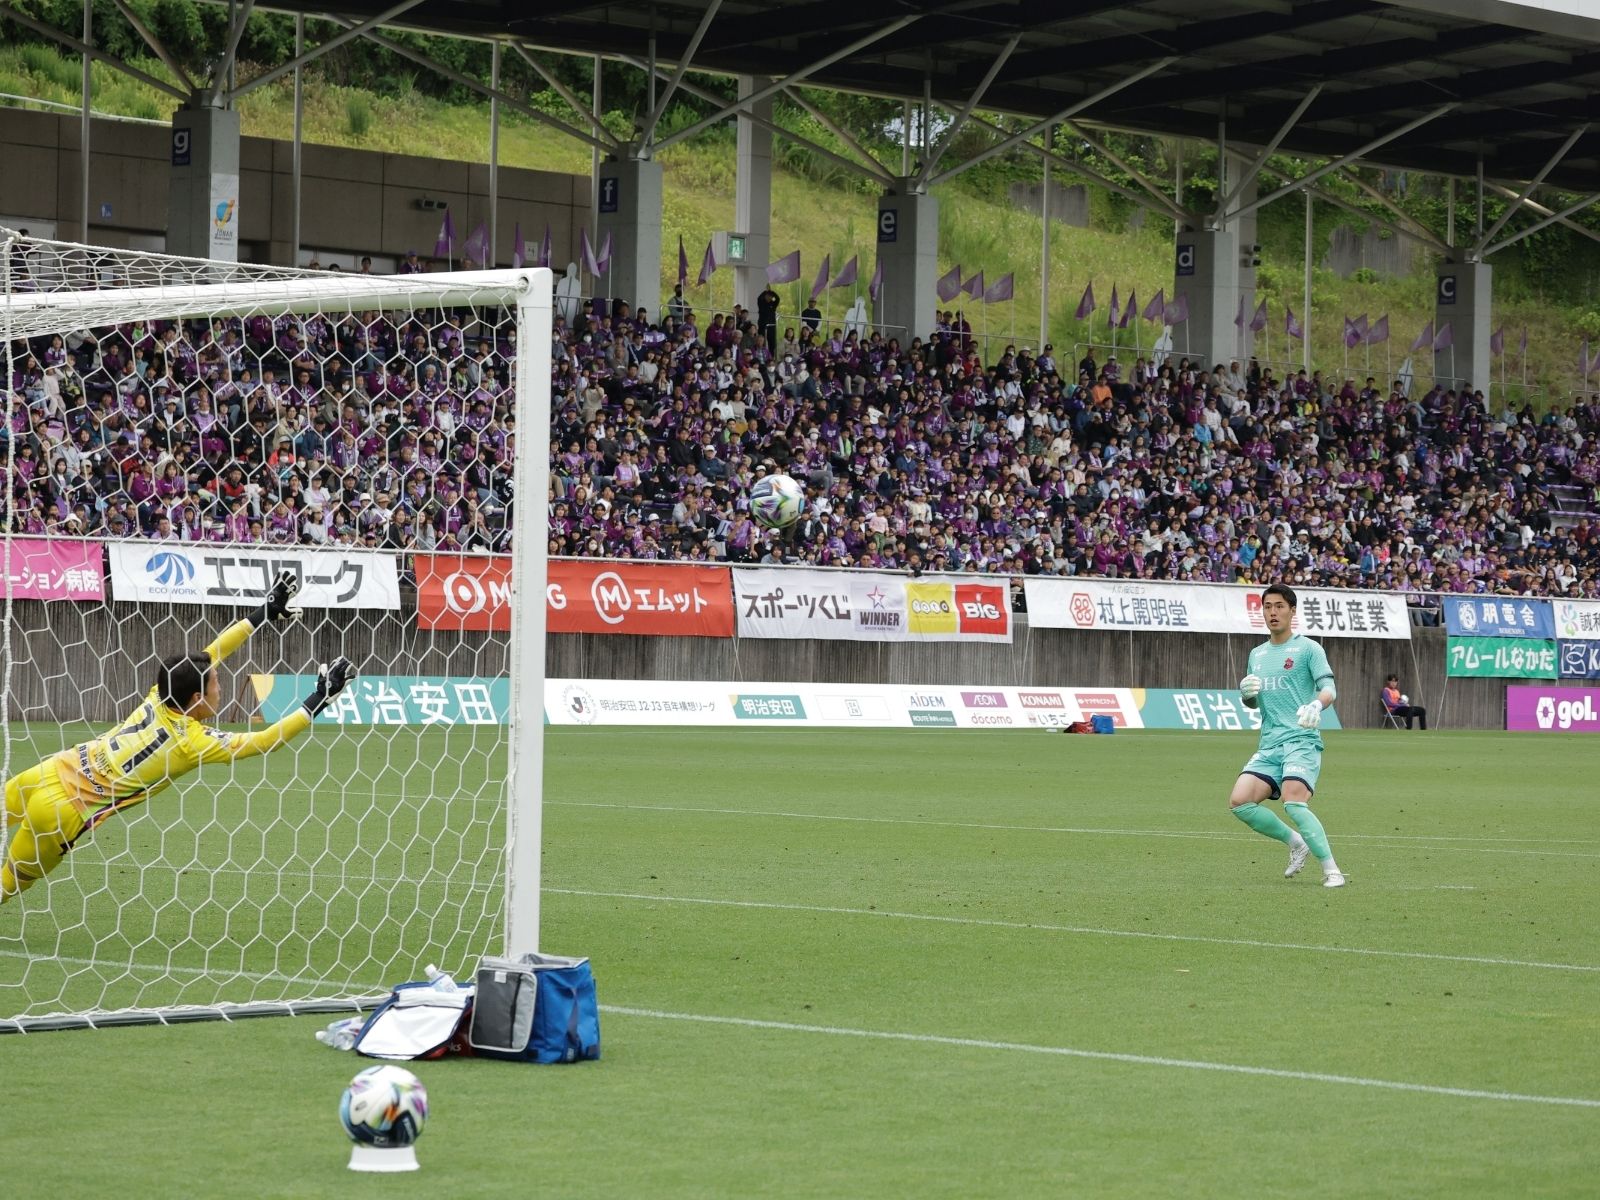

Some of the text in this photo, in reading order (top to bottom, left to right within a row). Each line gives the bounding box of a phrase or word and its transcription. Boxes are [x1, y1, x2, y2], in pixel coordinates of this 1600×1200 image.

[174, 130, 189, 154] g
[604, 179, 613, 202] f
[880, 211, 895, 233] e
[1178, 247, 1193, 267] d
[489, 580, 567, 610] MG
[635, 587, 708, 613] エムット
[741, 587, 852, 620] スポーツくじ
[859, 611, 900, 627] WINNER
[1097, 596, 1189, 627] 村上開明堂
[1302, 598, 1389, 633] 美光産業
[742, 698, 796, 715] 明治安田
[1021, 695, 1062, 705] KONAMI
[971, 713, 1013, 725] docomo
[1037, 713, 1070, 726] いちご
[108, 702, 172, 775] 21
